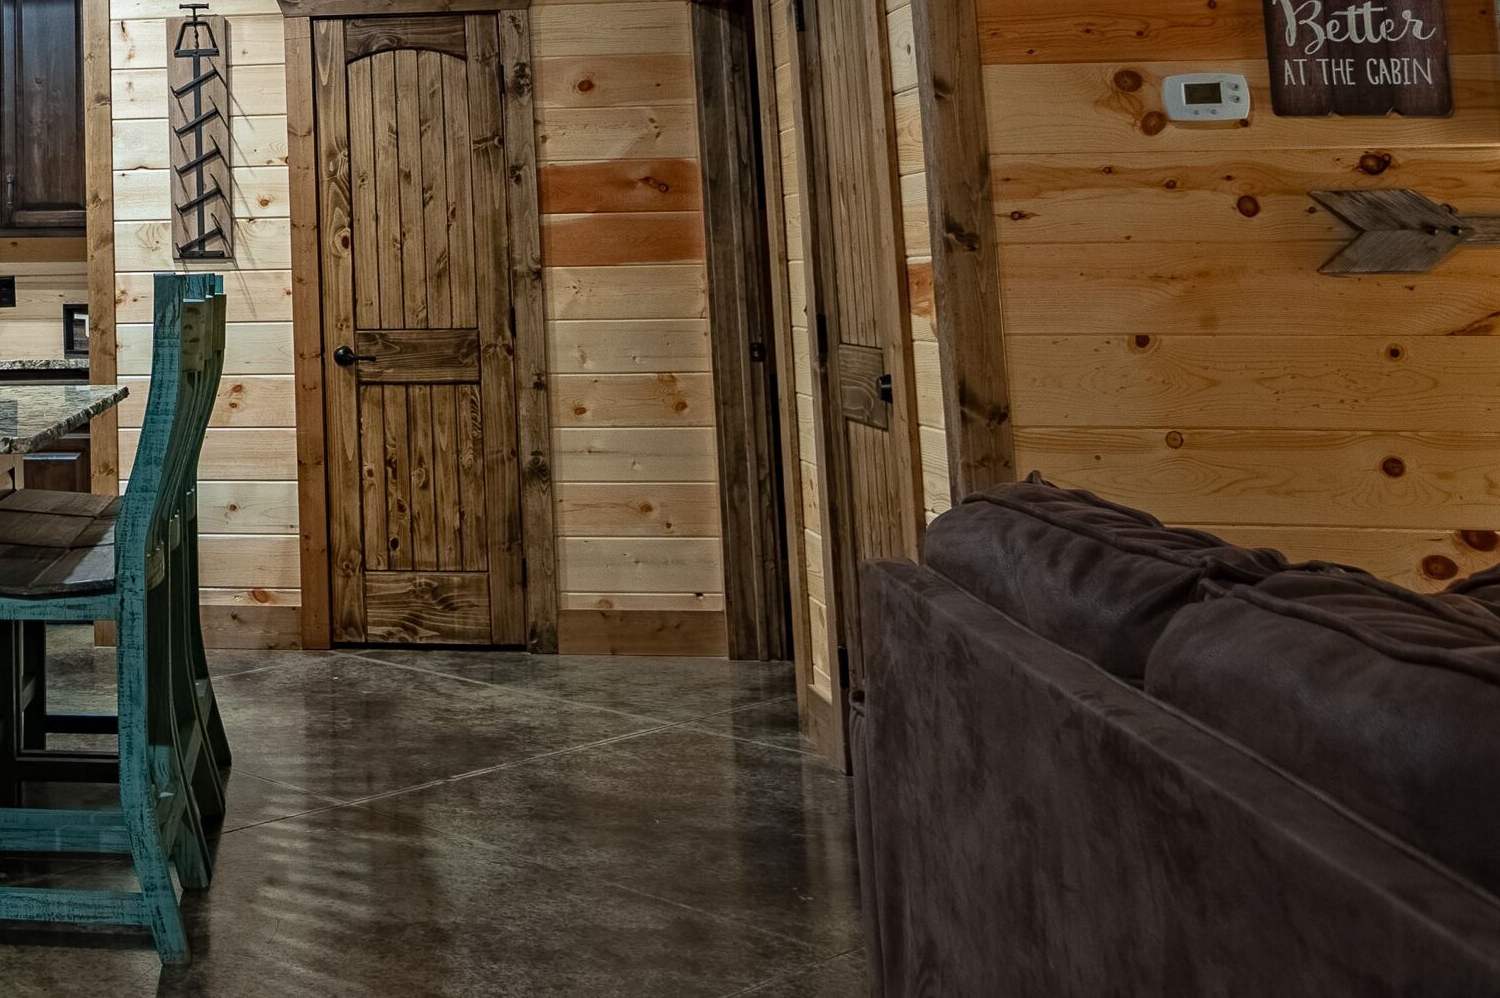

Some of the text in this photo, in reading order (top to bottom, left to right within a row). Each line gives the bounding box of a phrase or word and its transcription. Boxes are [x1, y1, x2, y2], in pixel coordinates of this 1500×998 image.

[1284, 57, 1434, 85] AT THE CABIN
